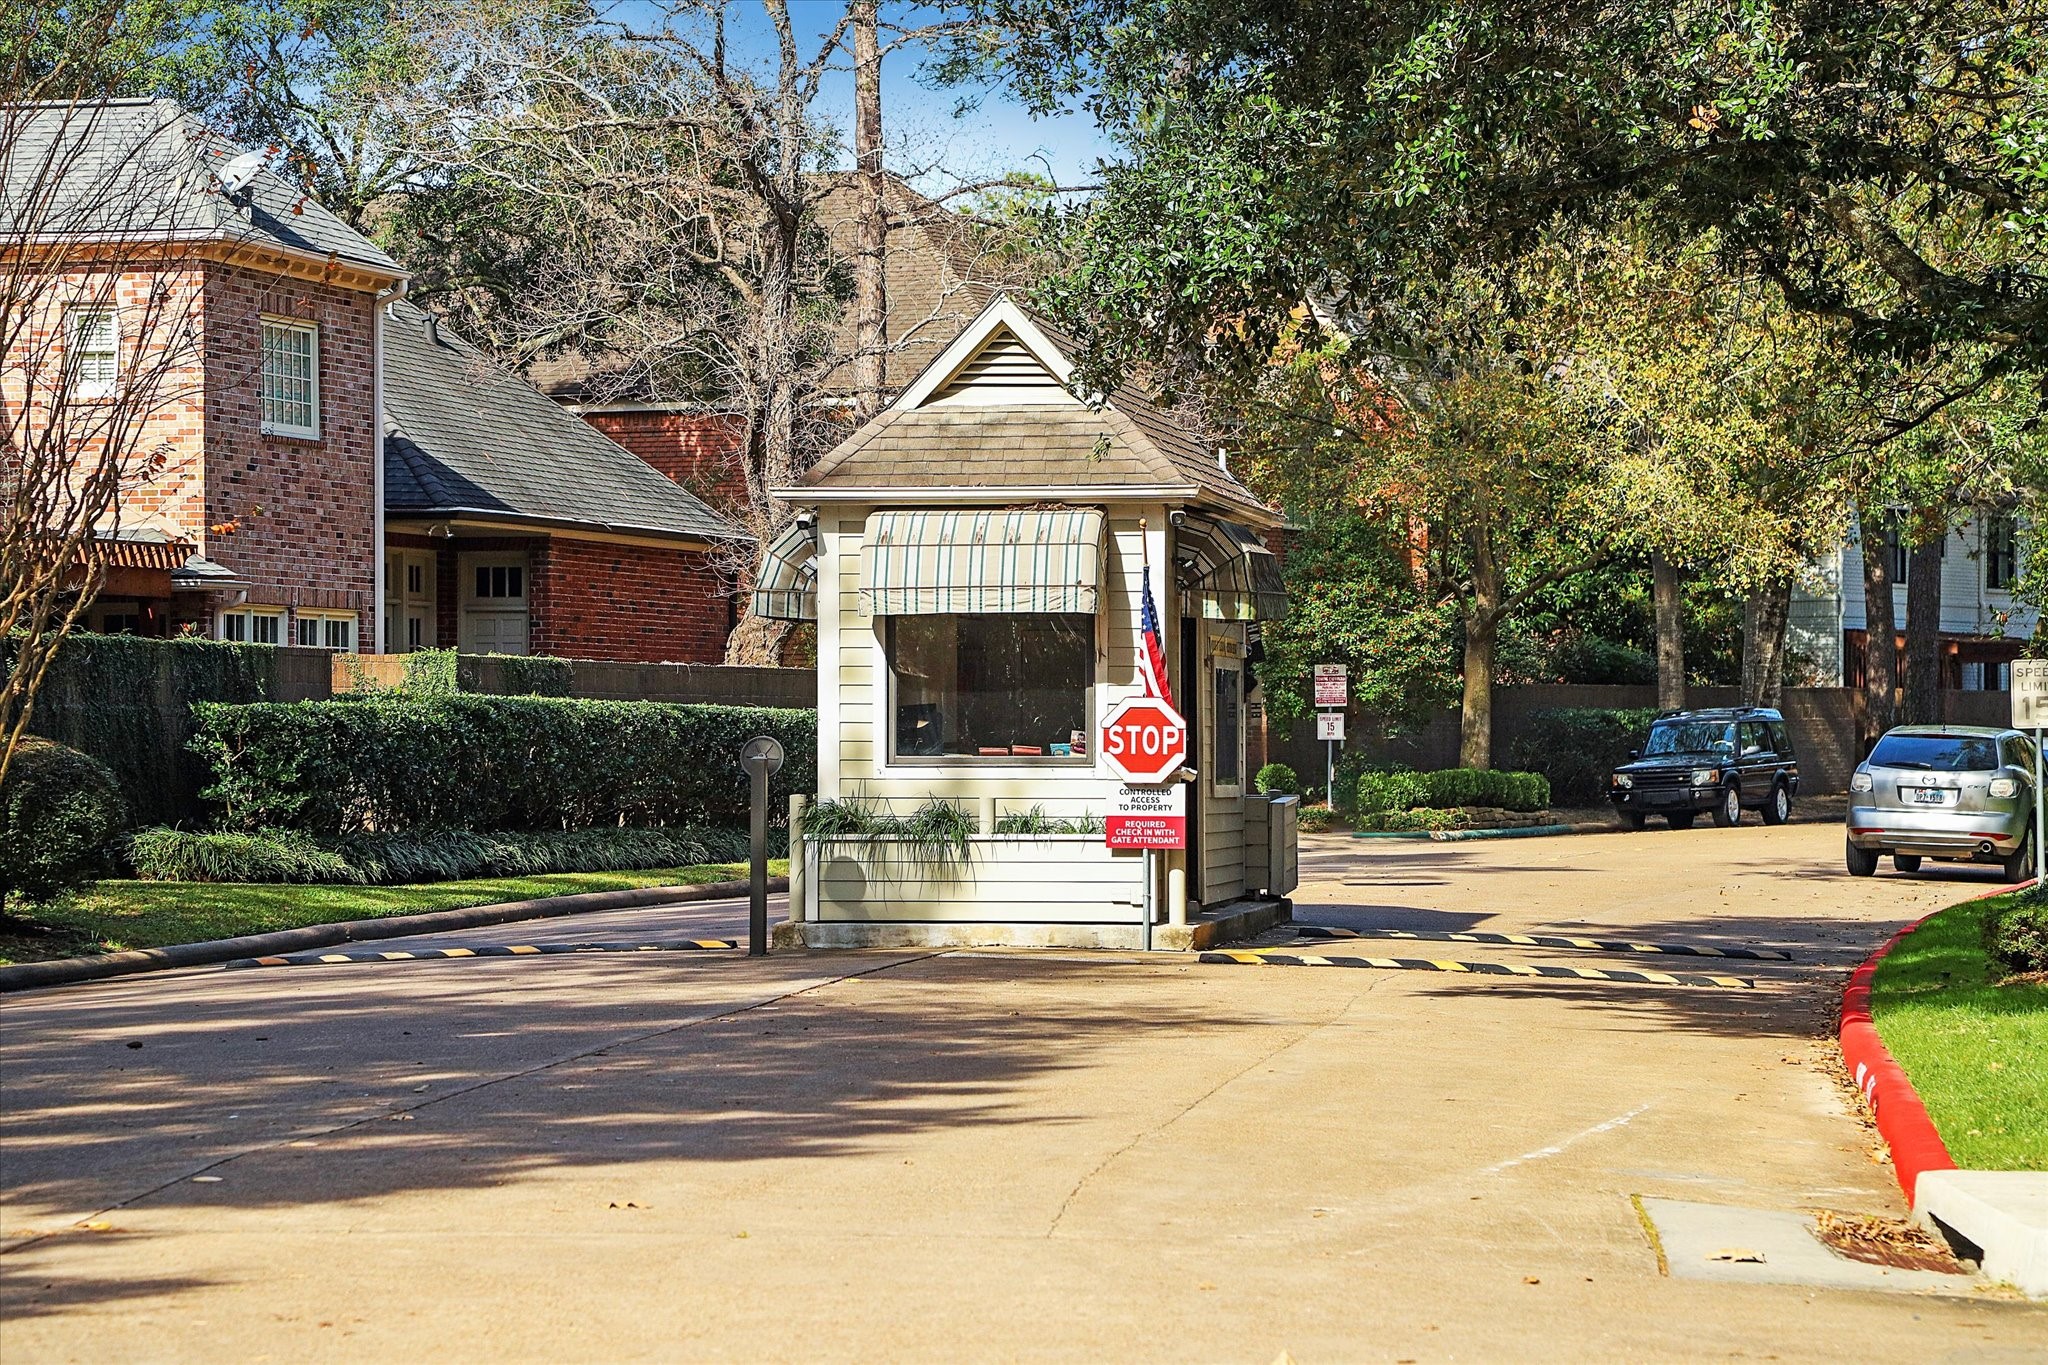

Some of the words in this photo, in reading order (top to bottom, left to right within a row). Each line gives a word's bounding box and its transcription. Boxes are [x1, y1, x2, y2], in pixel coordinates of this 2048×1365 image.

[2022, 696, 2048, 720] 15
[1327, 722, 1335, 732] 15
[1108, 725, 1179, 755] STOP
[1119, 788, 1172, 796] CONTROLLED
[1130, 796, 1160, 804] ACCESS
[1125, 820, 1166, 829] REQUIRED
[1115, 828, 1142, 836] CHECK
[1144, 828, 1153, 836] IN
[1154, 828, 1176, 836] WITH
[1111, 836, 1132, 844] GATE
[1132, 836, 1180, 844] ATTENDANT
